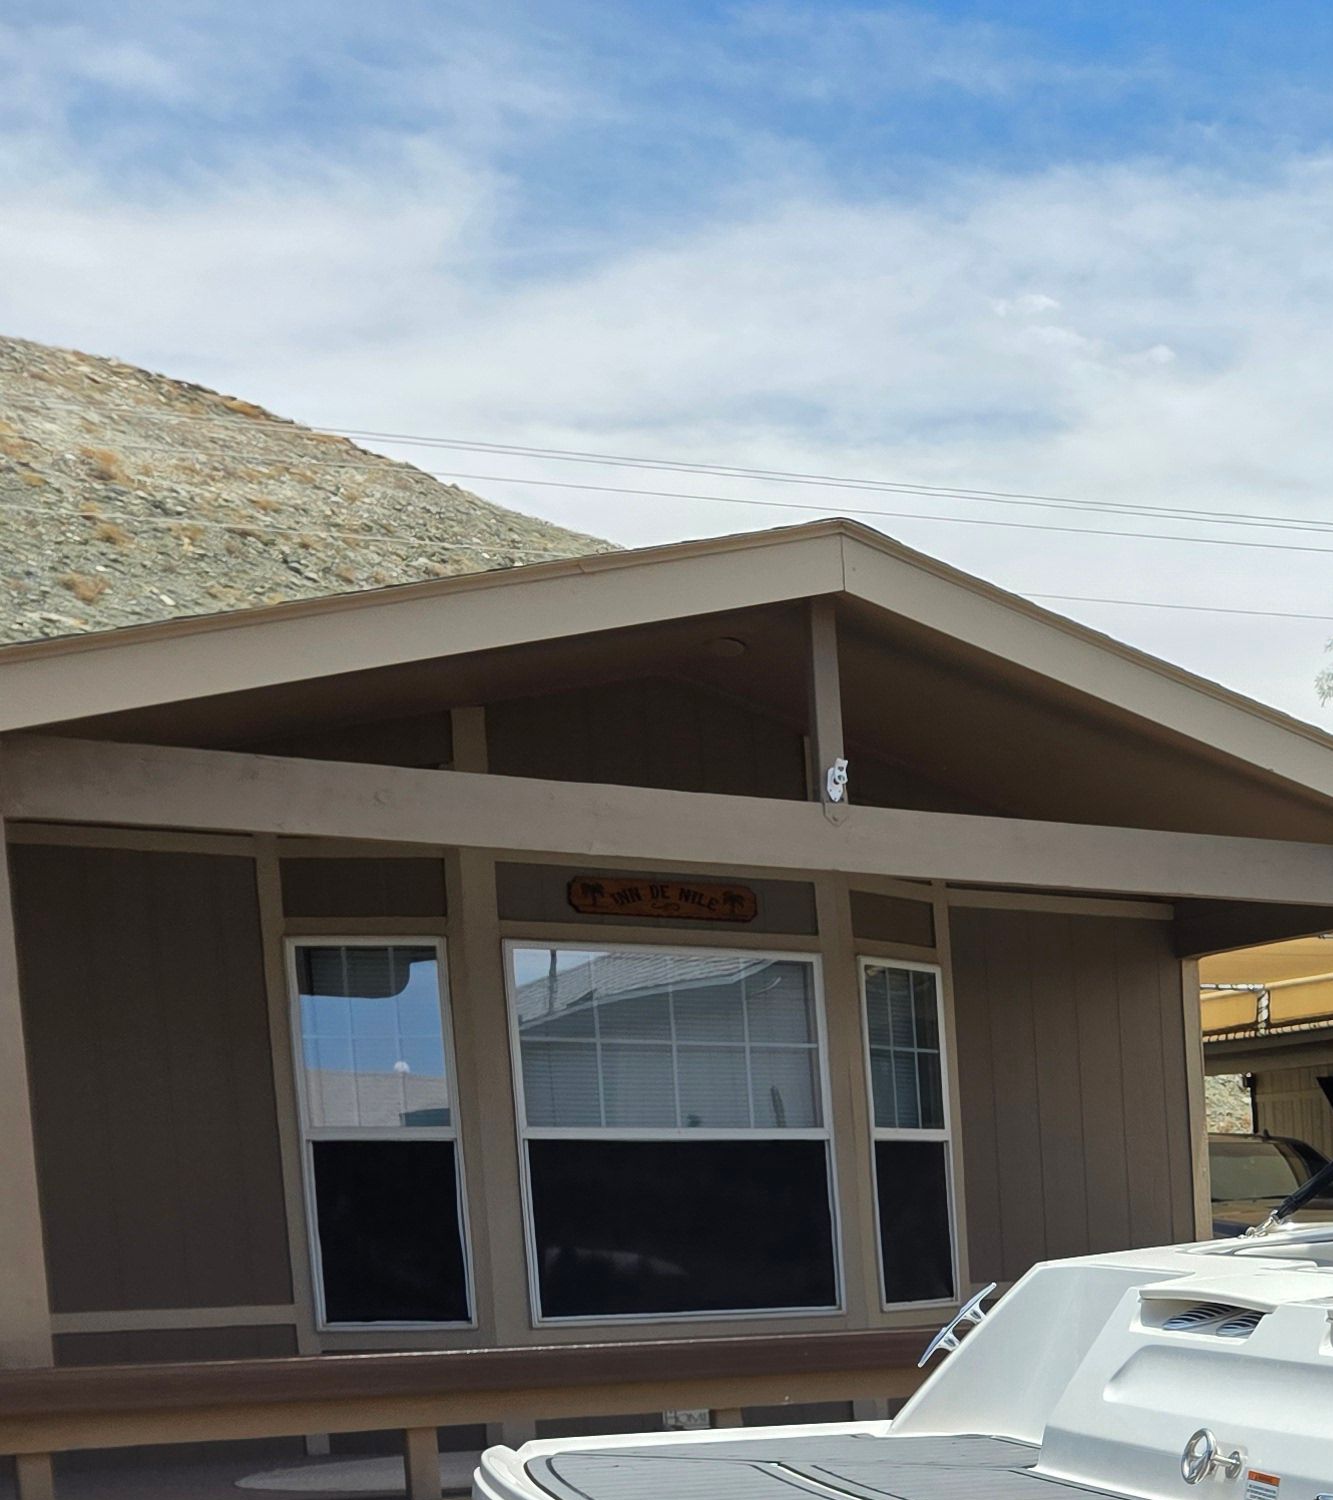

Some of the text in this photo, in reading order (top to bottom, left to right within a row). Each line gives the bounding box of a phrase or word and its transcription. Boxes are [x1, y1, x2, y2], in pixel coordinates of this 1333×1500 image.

[611, 884, 719, 911] INN DE NILE
